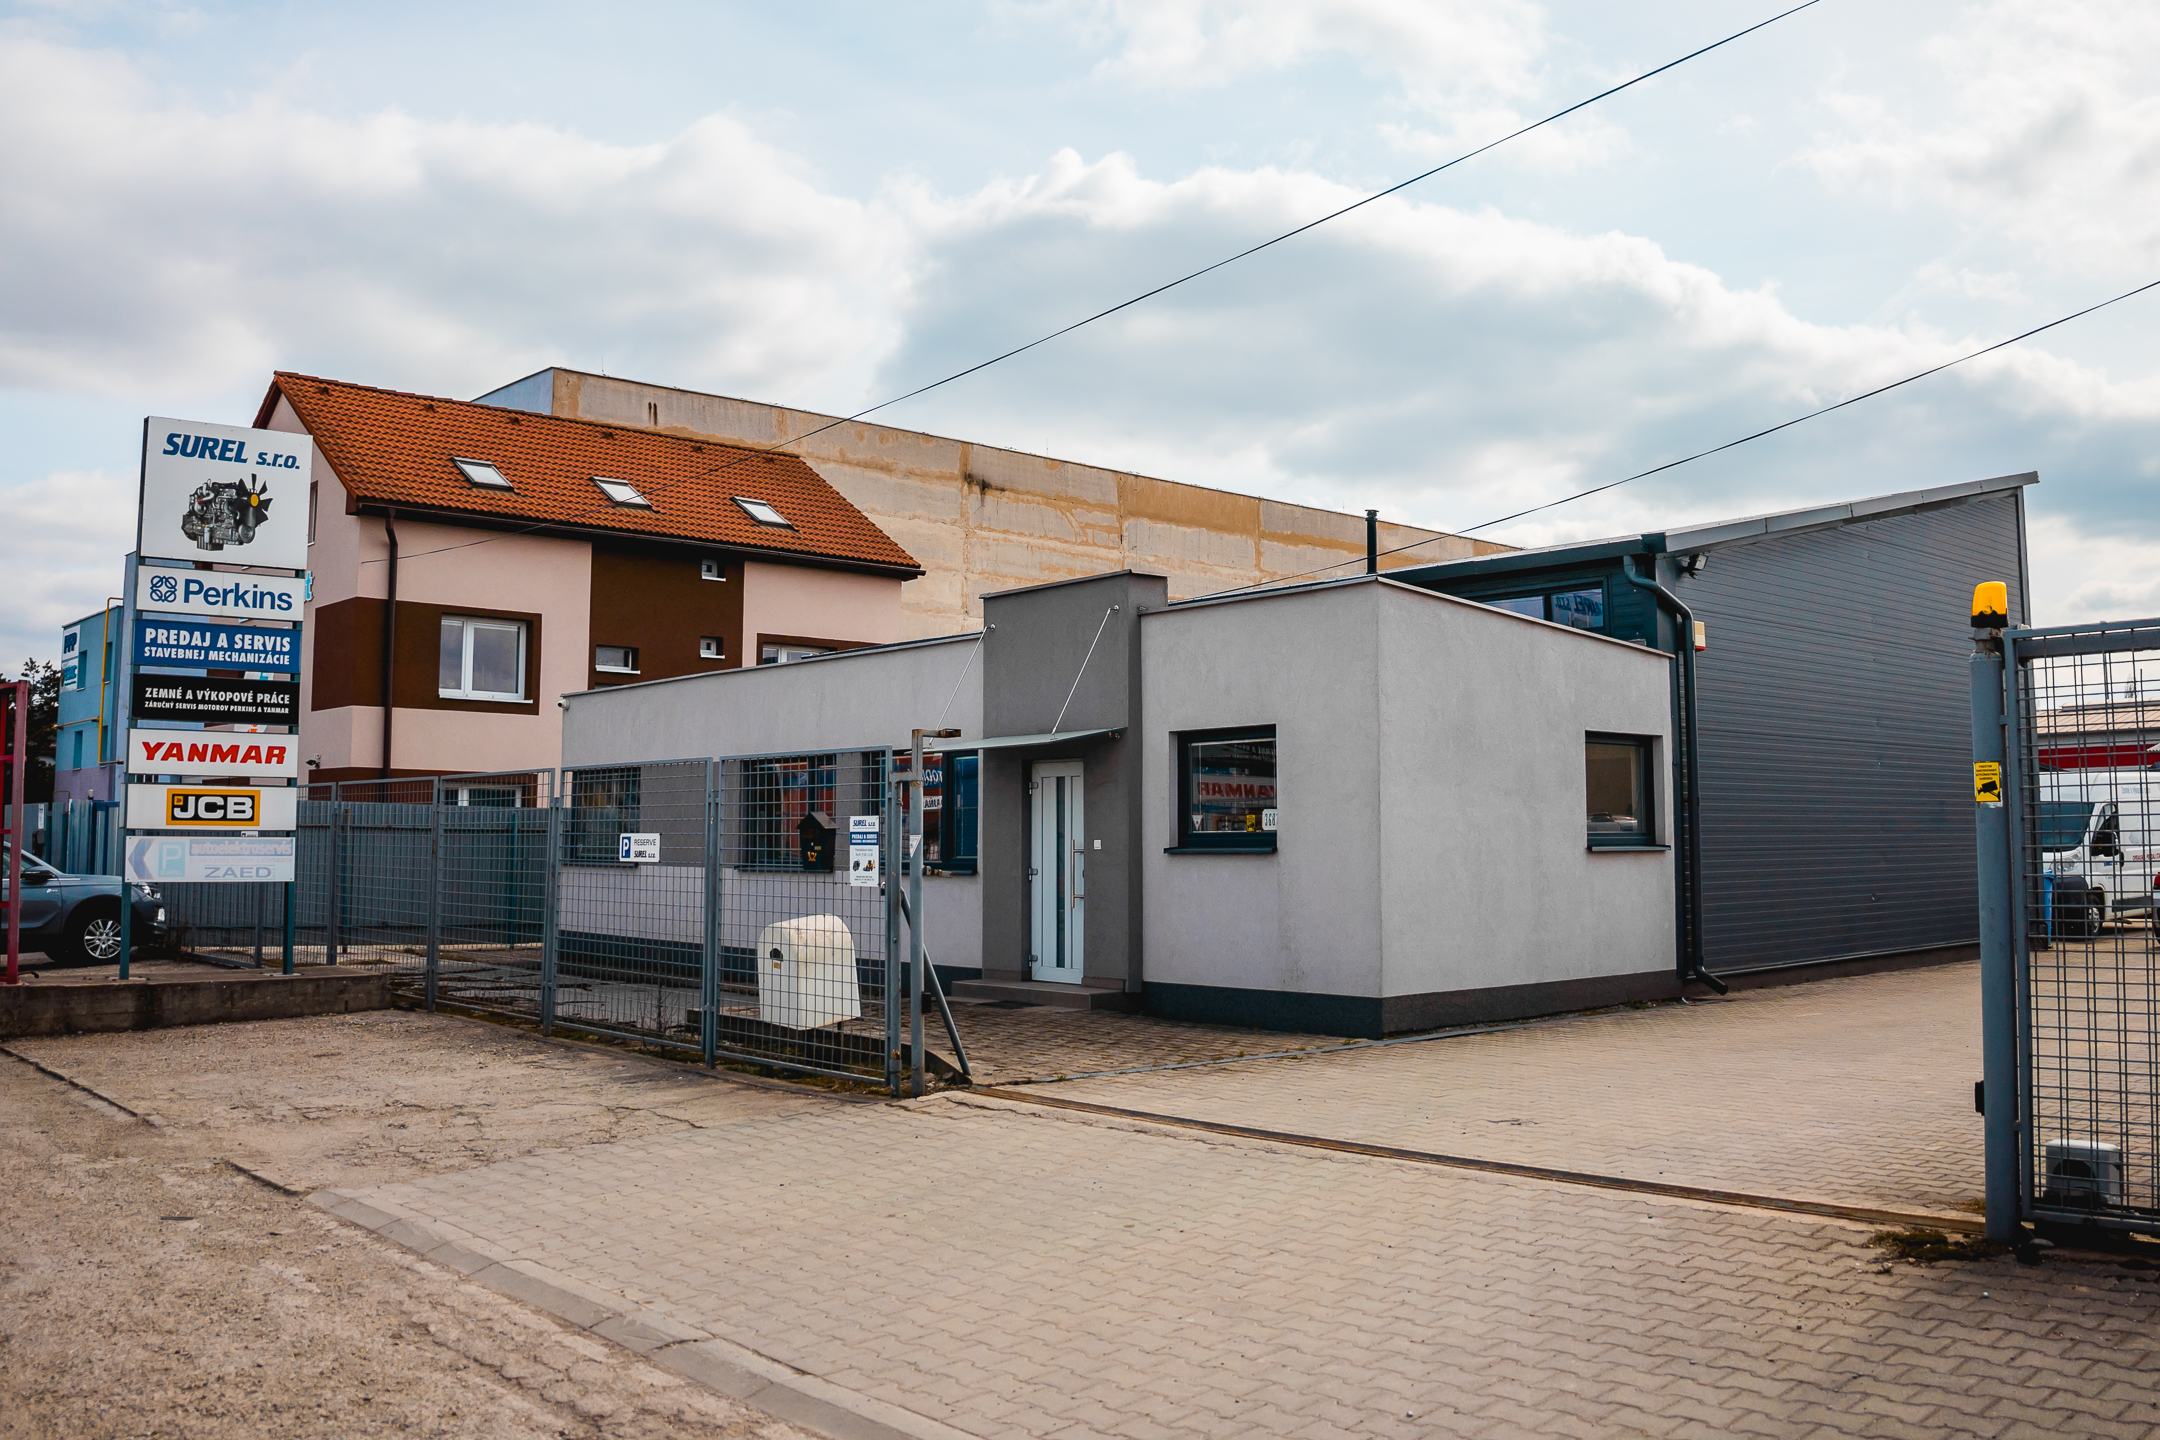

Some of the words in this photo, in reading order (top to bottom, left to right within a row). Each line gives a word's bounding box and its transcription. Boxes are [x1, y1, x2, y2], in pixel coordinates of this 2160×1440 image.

[163, 432, 248, 463] SUREL
[256, 452, 300, 469] s.r.o.
[184, 578, 292, 611] Perkins
[145, 628, 211, 647] PREDAJ
[217, 633, 228, 648] A
[234, 634, 291, 652] SERVIS
[144, 646, 205, 660] STAVEBNEJ
[208, 650, 290, 665] MECHANIZÁCIE
[145, 687, 182, 699] ZEMNÉ
[186, 690, 193, 700] A
[196, 688, 253, 703] VÝKOPOVÉ
[257, 691, 290, 705] PRÁCE
[144, 701, 174, 709] ZÁRUČNÝ
[175, 702, 197, 710] SERVIS
[198, 703, 229, 711] MOTOROV
[230, 705, 256, 713] PERKINS
[264, 706, 290, 714] YANMAR
[142, 741, 287, 765] YANMAR
[174, 796, 253, 820] JCB
[853, 819, 867, 827] SUREL
[191, 840, 292, 855] autoelektroservis
[623, 839, 630, 857] P
[634, 850, 647, 858] SUREL
[204, 867, 272, 878] ZAED
